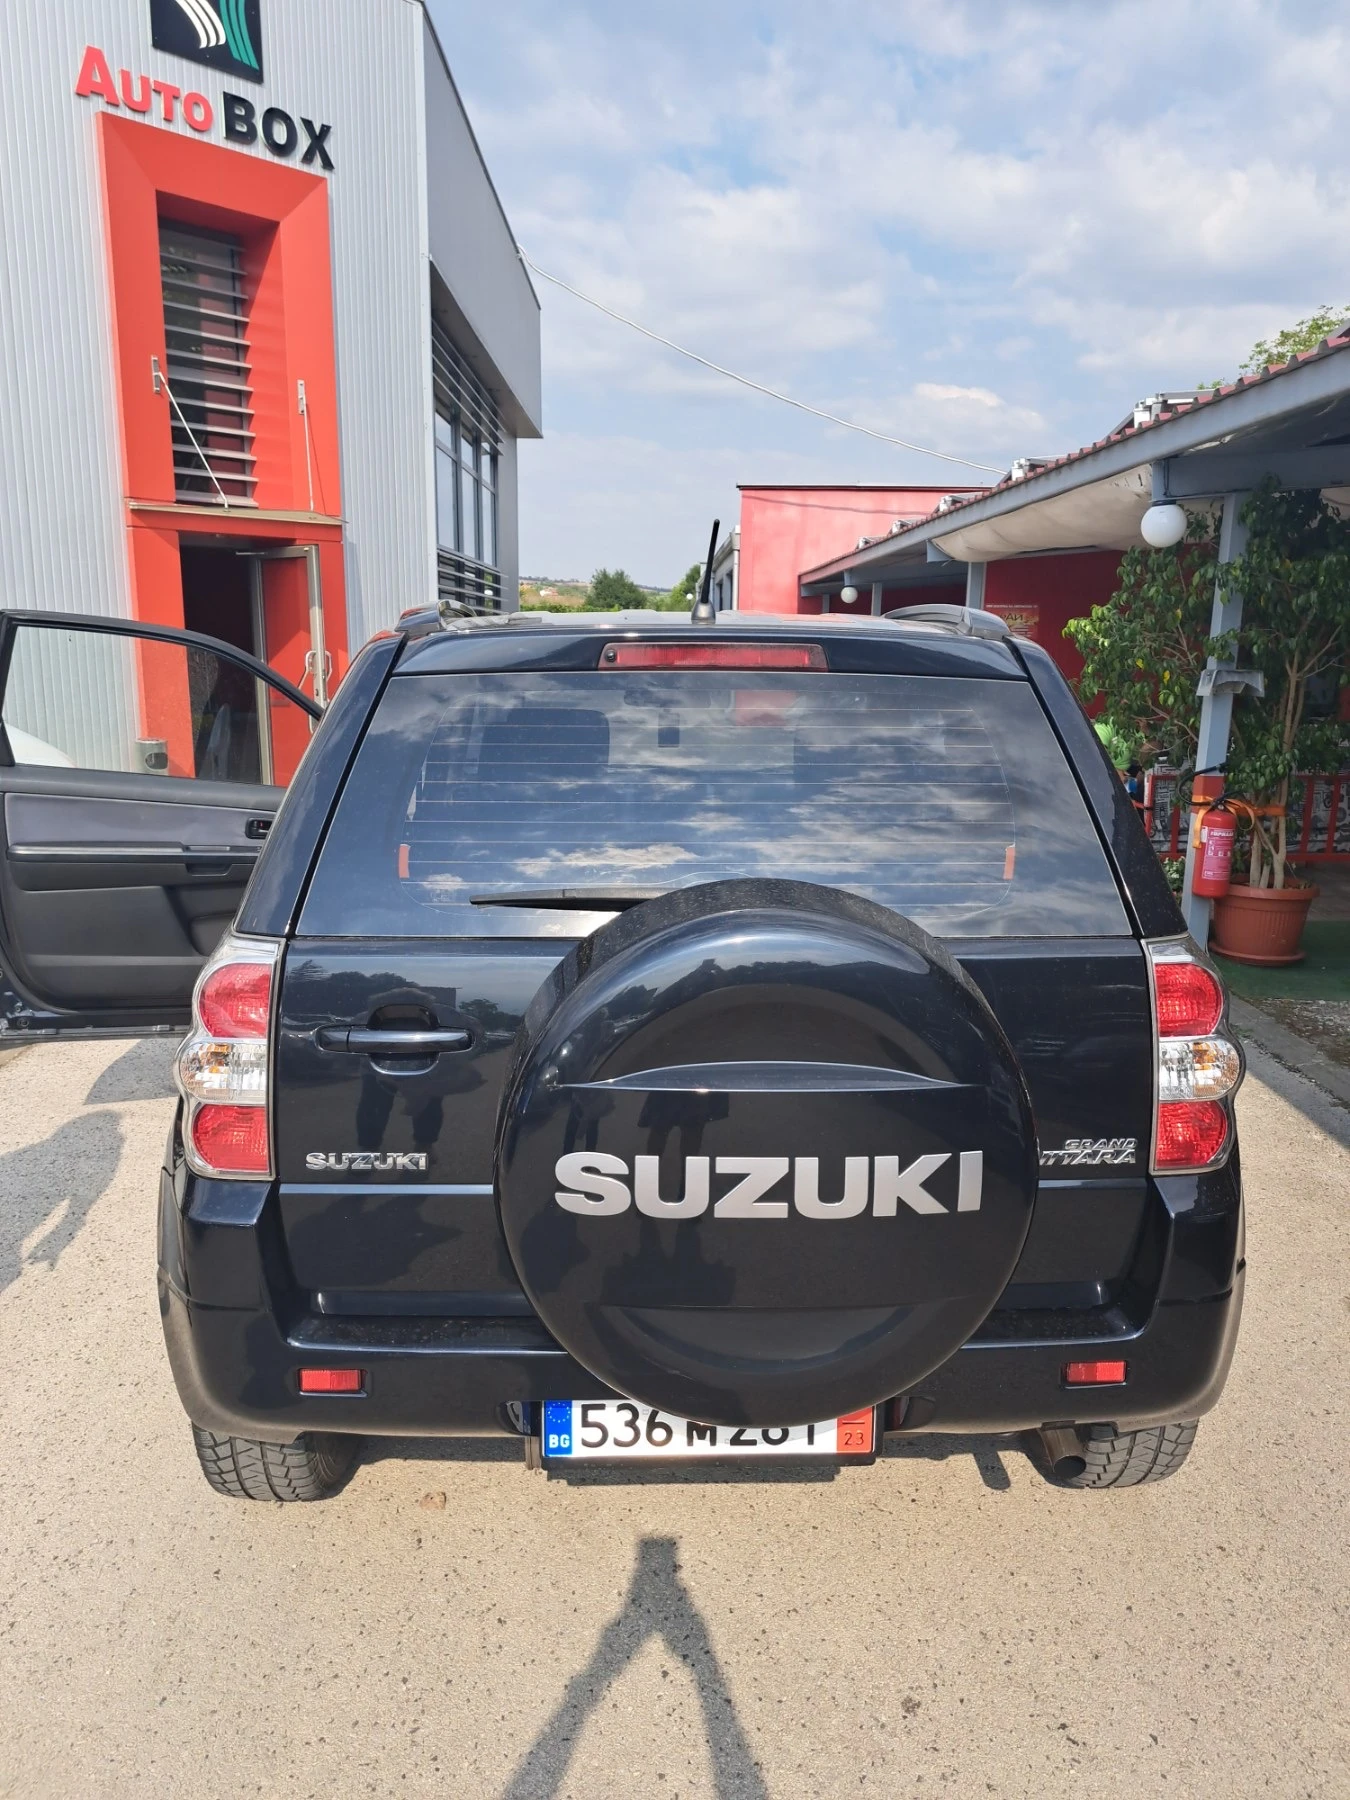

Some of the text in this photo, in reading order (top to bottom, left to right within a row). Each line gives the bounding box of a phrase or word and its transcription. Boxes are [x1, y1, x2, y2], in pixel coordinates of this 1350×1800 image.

[75, 44, 335, 171] AUTO BOX
[1064, 1138, 1138, 1150] GRAND
[305, 1152, 427, 1170] SUZUKI
[555, 1150, 984, 1219] SUZUKI
[548, 1434, 571, 1449] BG
[843, 1432, 865, 1446] 23
